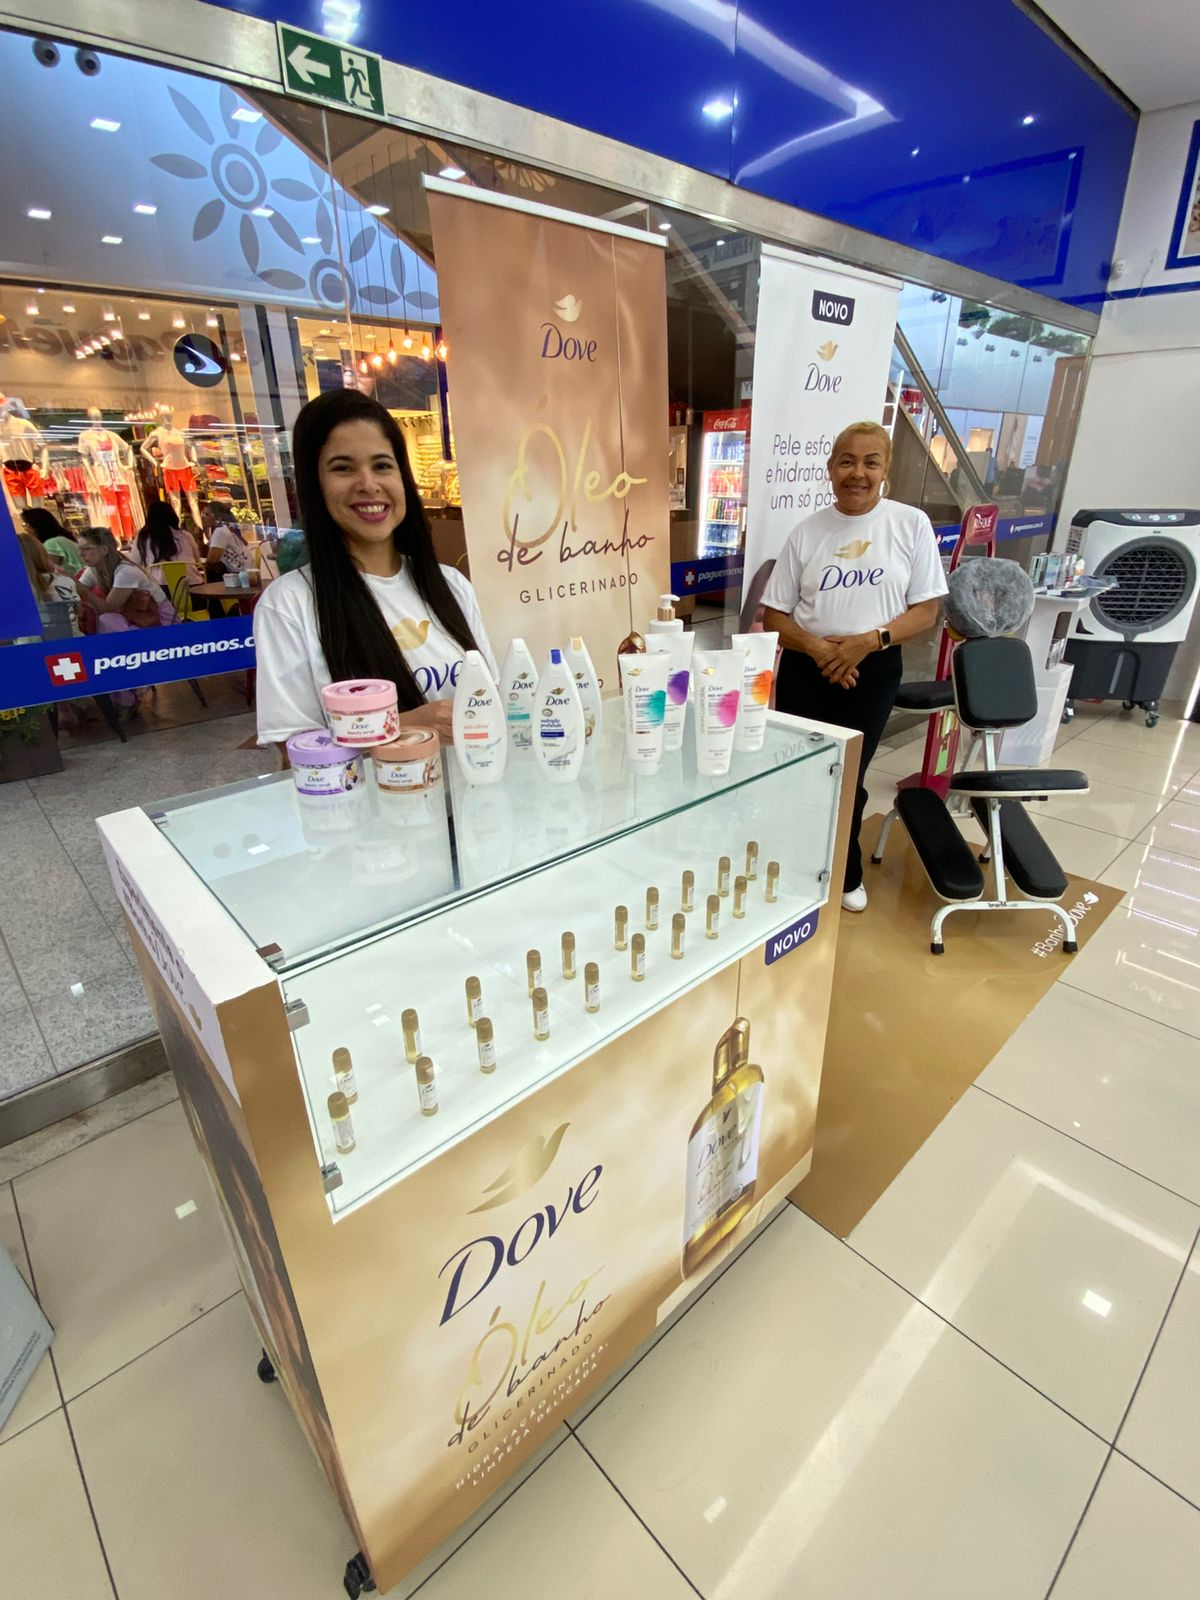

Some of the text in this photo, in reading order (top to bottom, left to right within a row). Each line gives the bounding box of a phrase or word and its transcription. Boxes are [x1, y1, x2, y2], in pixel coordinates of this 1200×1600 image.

[819, 299, 848, 320] NOVO
[540, 322, 599, 363] Dove
[804, 362, 842, 393] Dove
[773, 433, 801, 455] Pele
[766, 468, 773, 483] e
[770, 494, 794, 510] um
[798, 488, 811, 508] só
[496, 508, 655, 573] de banho
[519, 573, 639, 604] GLICERINADO
[698, 567, 745, 583] paguemeno
[819, 564, 884, 591] Dove
[94, 636, 256, 675] paguemenos.c
[412, 660, 463, 695] ove
[512, 680, 534, 690] Dove
[467, 697, 492, 707] Dove
[545, 695, 570, 705] Dove
[773, 922, 811, 957] NOVO
[438, 1164, 603, 1327] Dove
[454, 1264, 605, 1426] Óleo
[447, 1294, 612, 1447] de banho
[468, 1333, 592, 1453] GLICERINADO
[473, 1363, 597, 1486] LIMPEZA DELICADA
[456, 1399, 546, 1489] HIDRATAÇÃO
